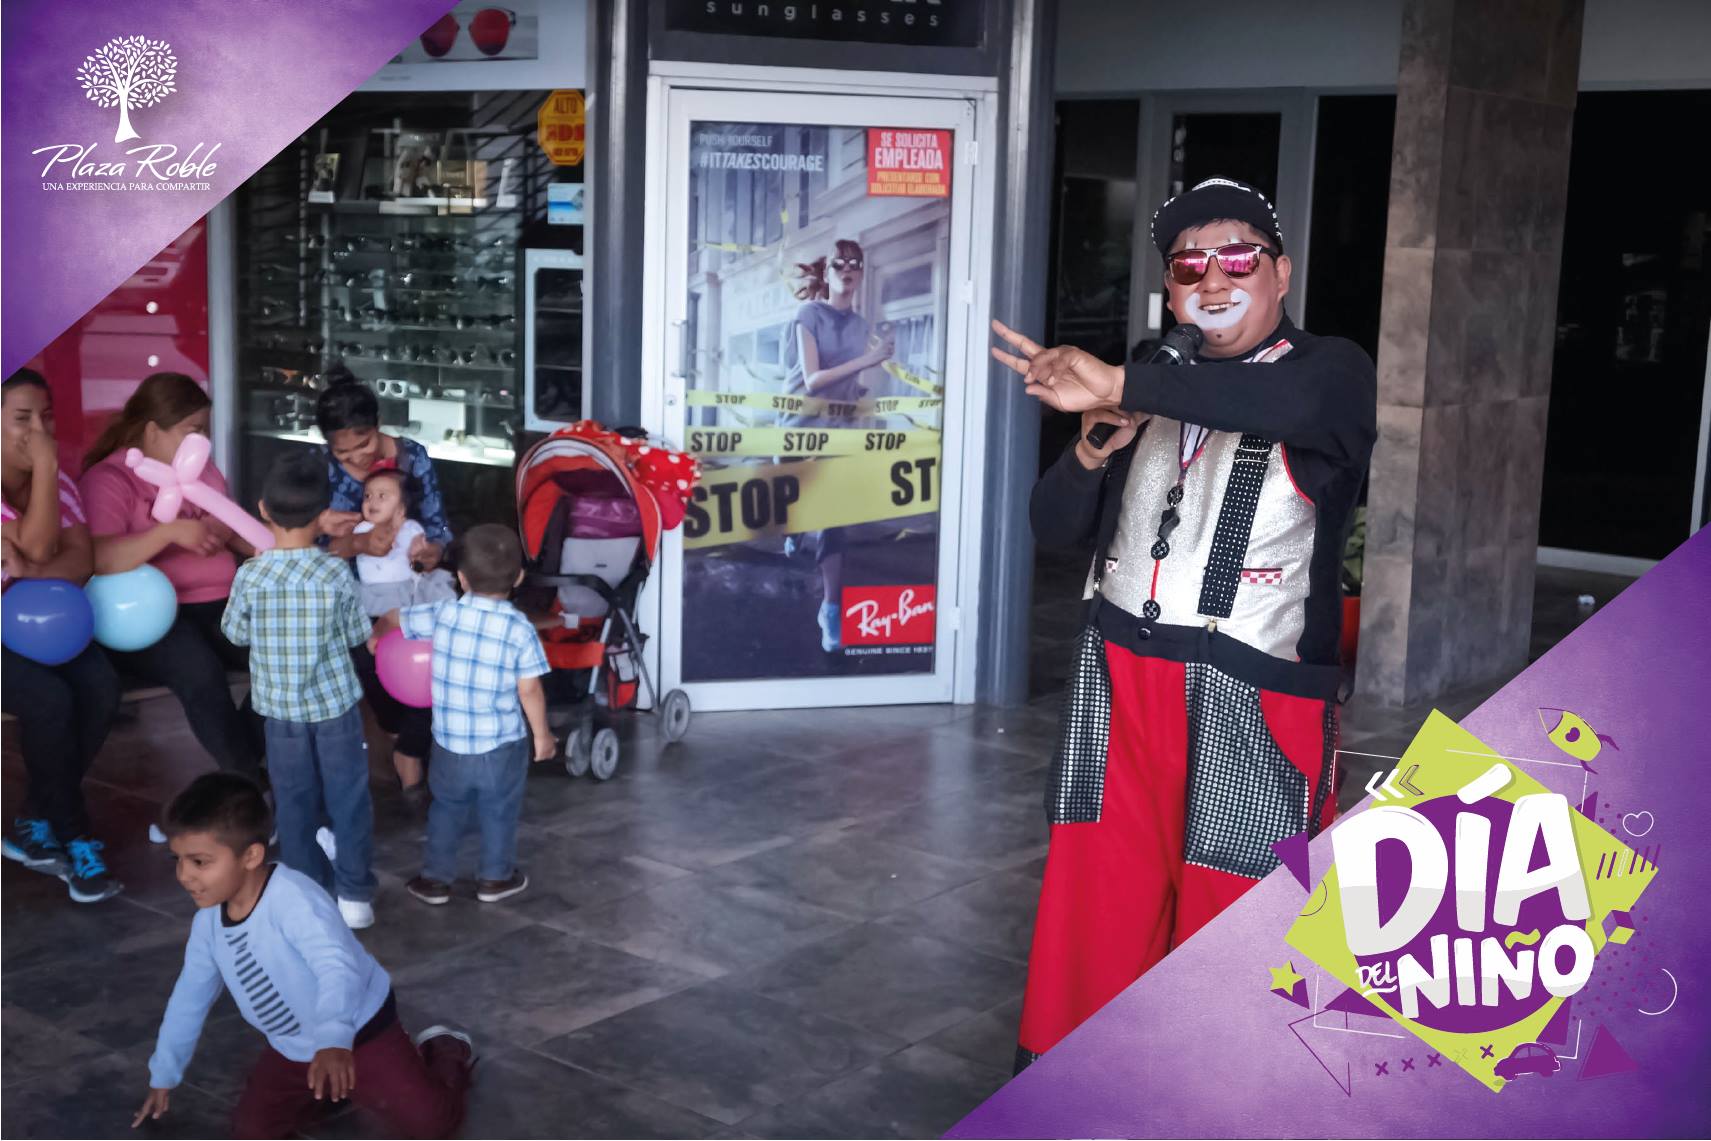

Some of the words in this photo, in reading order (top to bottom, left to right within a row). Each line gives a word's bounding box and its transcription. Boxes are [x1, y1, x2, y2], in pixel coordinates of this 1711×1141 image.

[706, 1, 938, 26] sunglasses
[880, 132, 893, 147] SE
[895, 132, 938, 148] SOLICITA
[700, 152, 824, 172] #ITTAKESCOURAGE
[875, 147, 944, 170] EMPLEADA
[715, 393, 747, 404] STOP
[772, 396, 803, 411] STOP
[828, 403, 857, 416] STOP
[876, 400, 899, 413] STOP
[691, 432, 742, 452] STOP
[783, 433, 829, 451] STOP
[865, 433, 906, 450] STOP
[684, 475, 800, 538] STOP
[846, 588, 934, 637] Ray-Ban
[845, 647, 882, 656] GENUINE
[885, 647, 911, 655] SINCE
